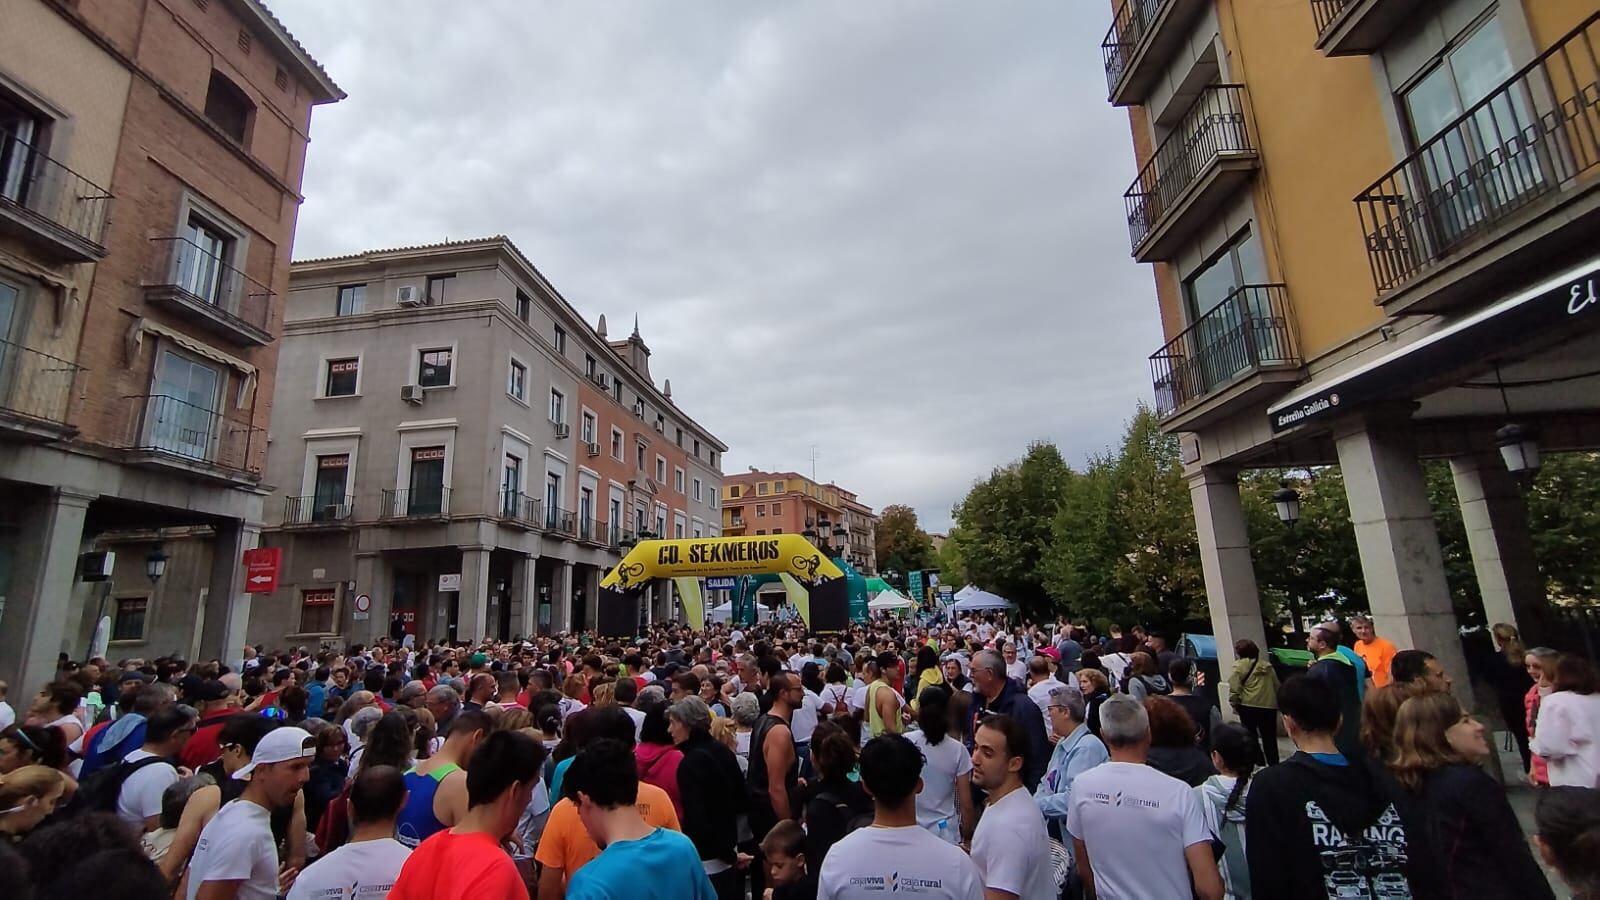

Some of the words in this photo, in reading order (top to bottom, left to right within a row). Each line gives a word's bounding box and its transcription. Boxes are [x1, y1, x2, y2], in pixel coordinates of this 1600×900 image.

[1278, 409, 1305, 426] Estrella
[1303, 399, 1330, 417] Galicia
[689, 540, 778, 564] SEXMEROS
[707, 577, 735, 588] SALIDA
[1312, 823, 1405, 847] RAING
